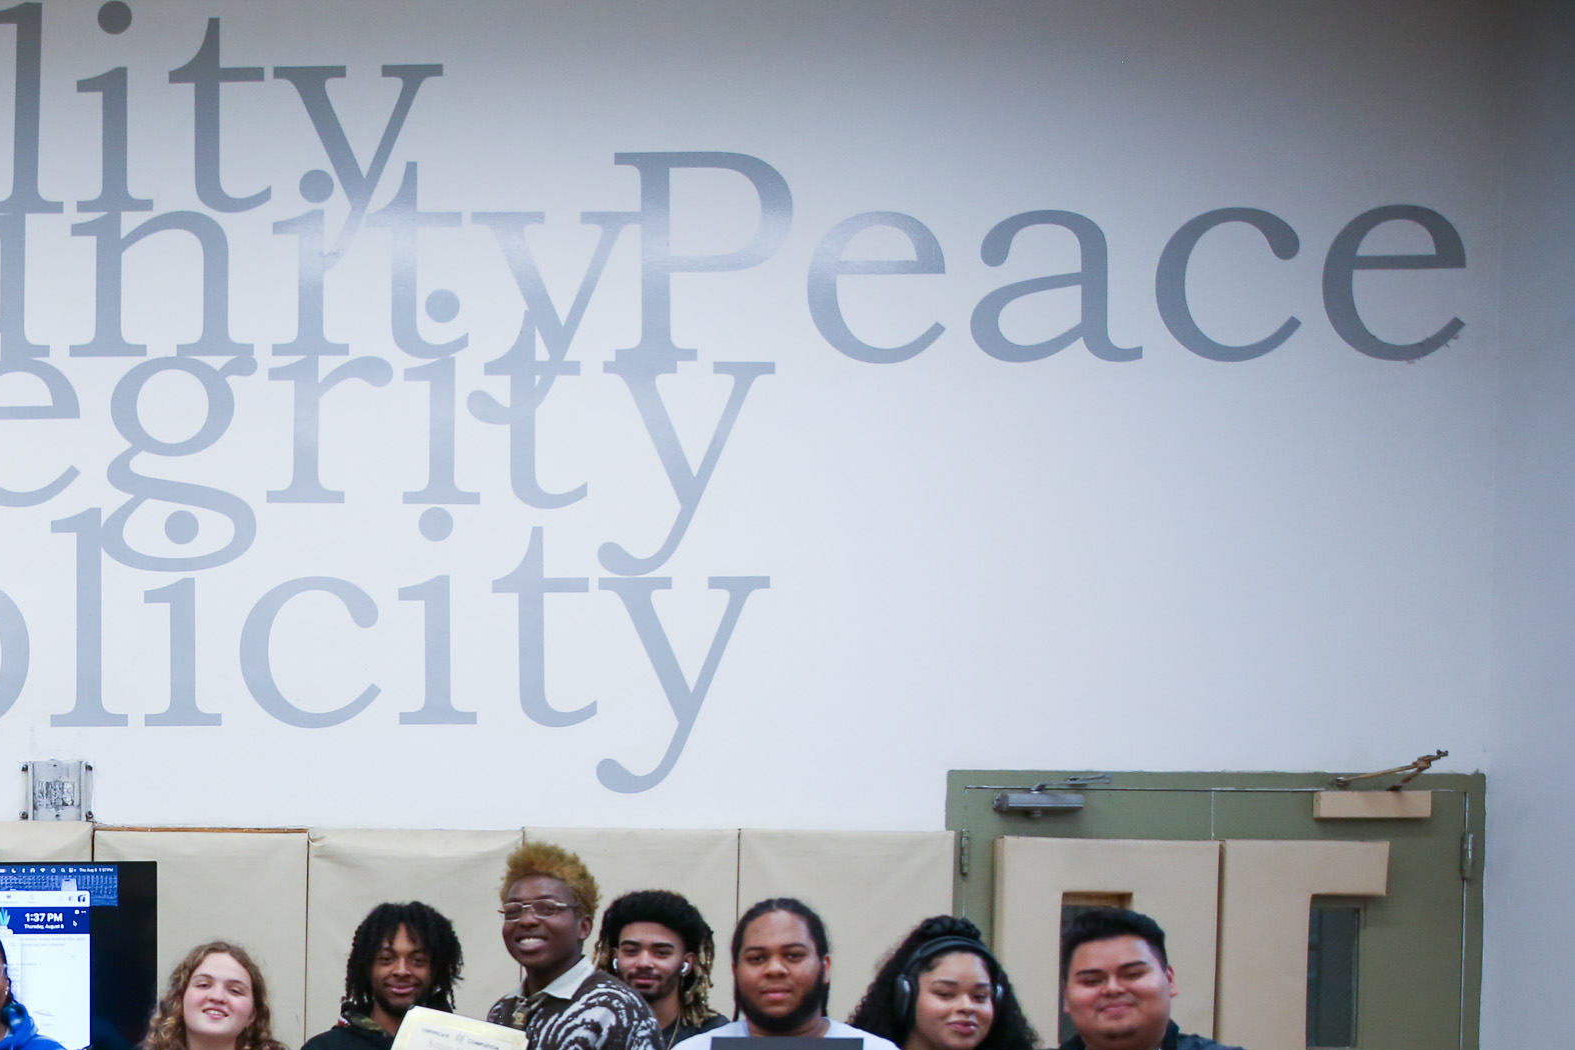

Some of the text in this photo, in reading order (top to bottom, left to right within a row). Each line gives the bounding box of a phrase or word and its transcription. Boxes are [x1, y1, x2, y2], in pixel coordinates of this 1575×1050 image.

[614, 150, 1468, 364] Peace
[25, 912, 63, 922] 1:37 PM
